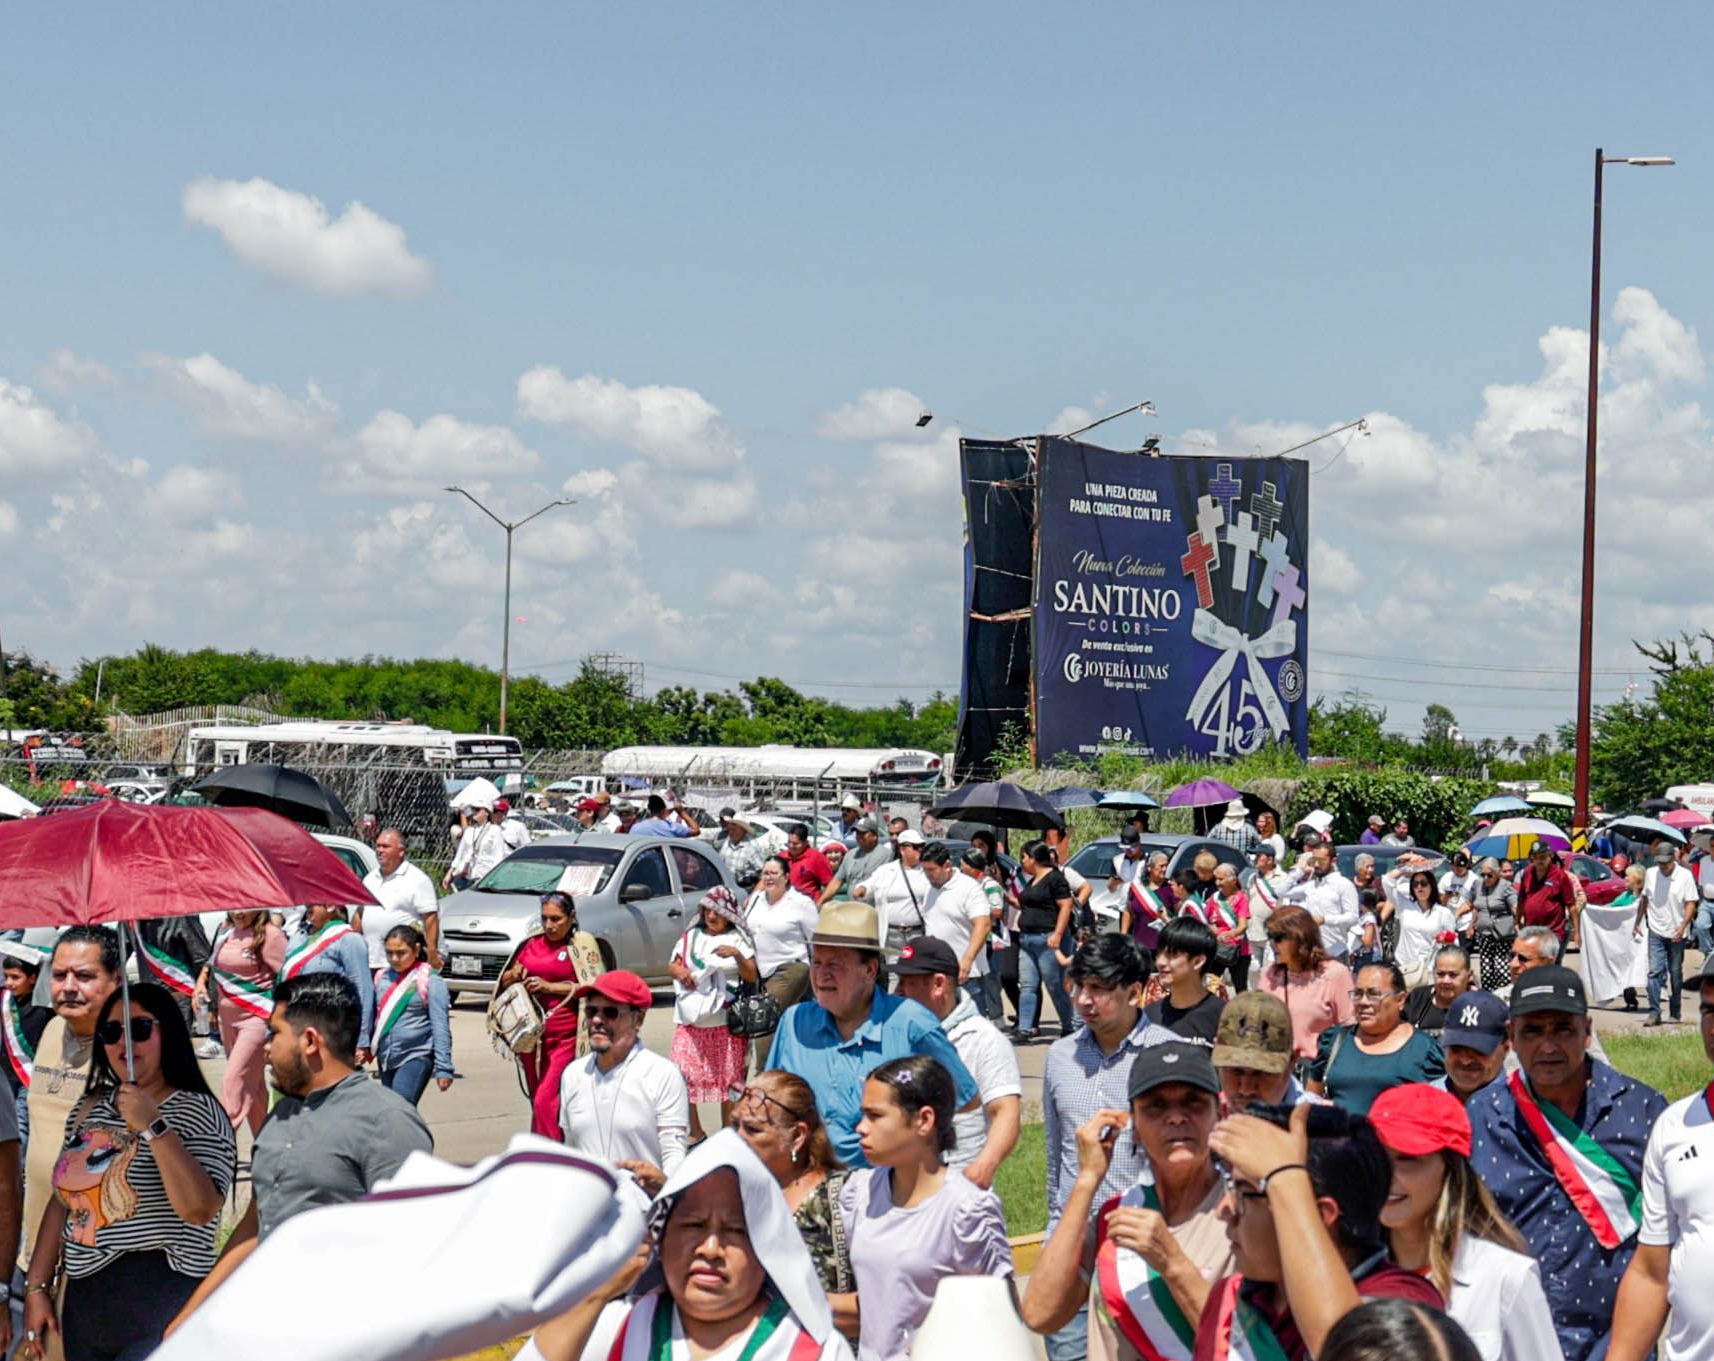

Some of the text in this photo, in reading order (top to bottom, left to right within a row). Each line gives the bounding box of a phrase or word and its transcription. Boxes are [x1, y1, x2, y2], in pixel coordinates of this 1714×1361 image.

[1085, 482, 1158, 503] UNA PIEZA CREADA
[1069, 499, 1172, 522] PARA CONECTAR CON TU FE
[1053, 580, 1181, 620] SANTINO
[1088, 618, 1151, 636] COLORS
[1083, 660, 1169, 680] JOYERÍA LUNAS
